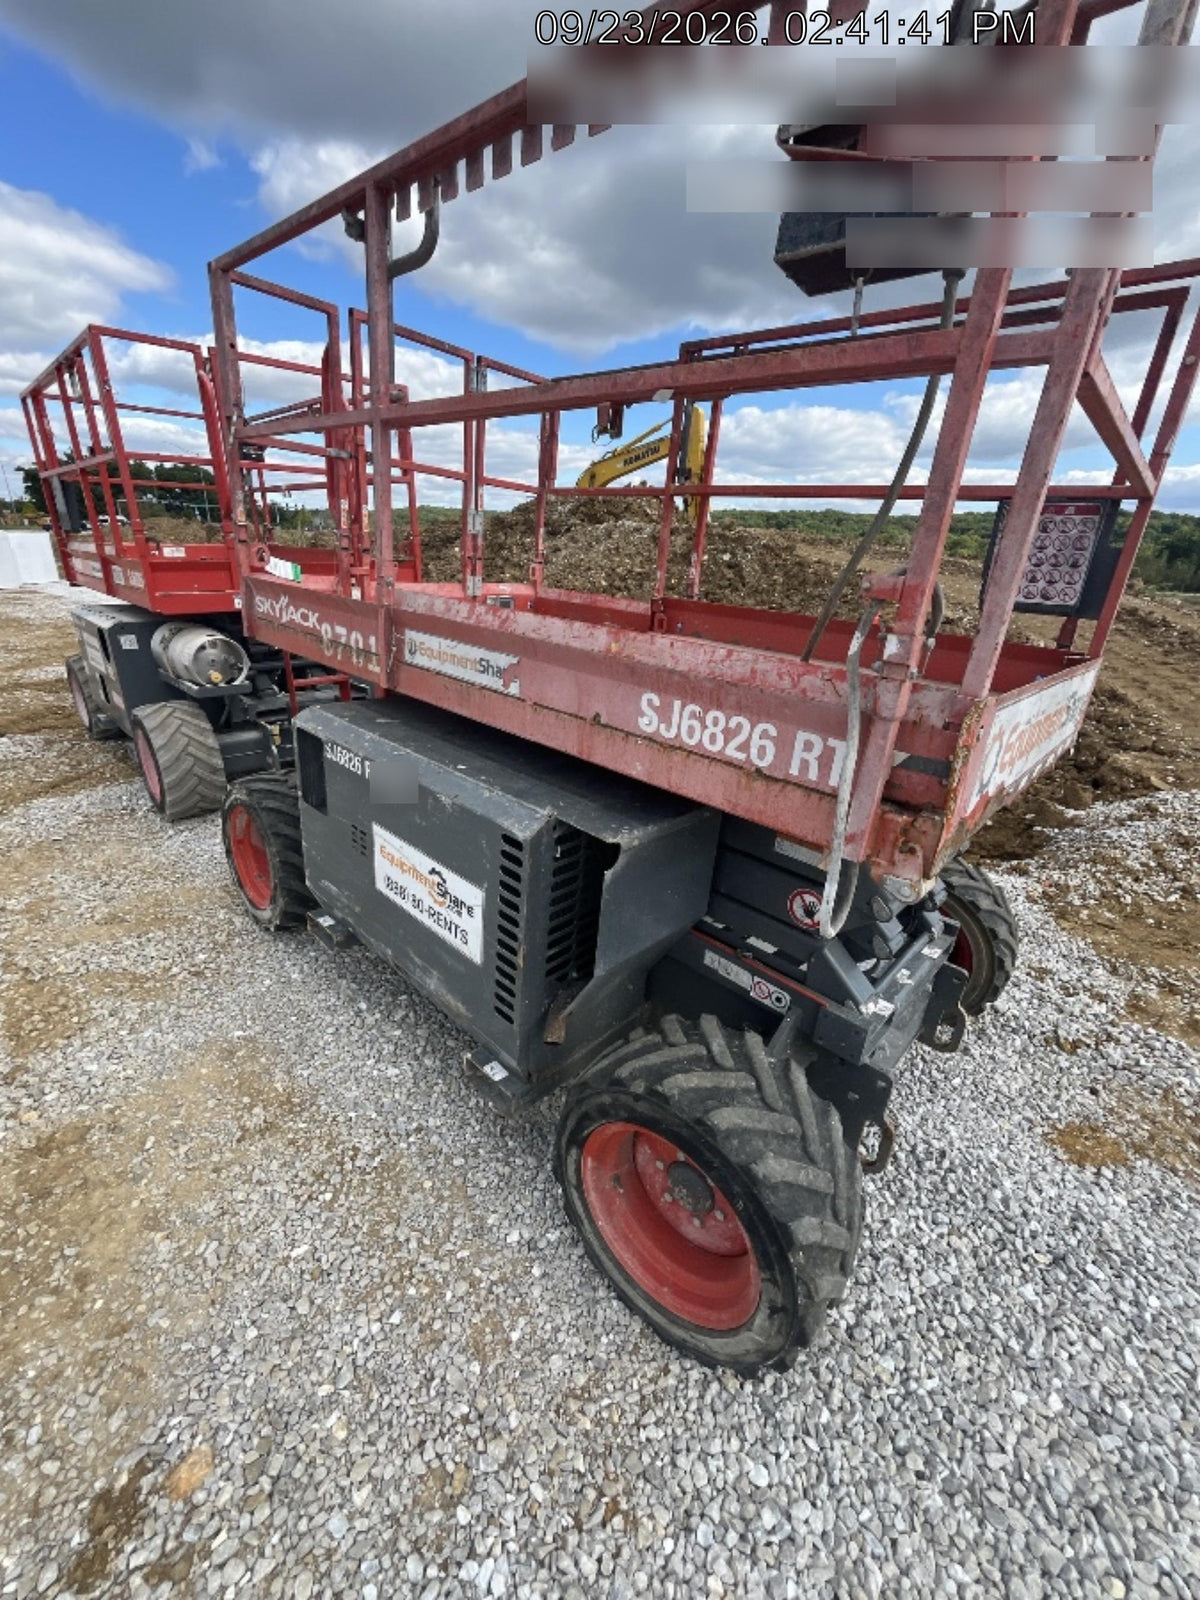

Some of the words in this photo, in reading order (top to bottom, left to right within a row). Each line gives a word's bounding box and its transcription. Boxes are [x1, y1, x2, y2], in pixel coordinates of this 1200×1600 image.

[255, 595, 320, 630] SKYJACK
[637, 692, 778, 768] SJ6826
[324, 742, 362, 776] SJ6826
